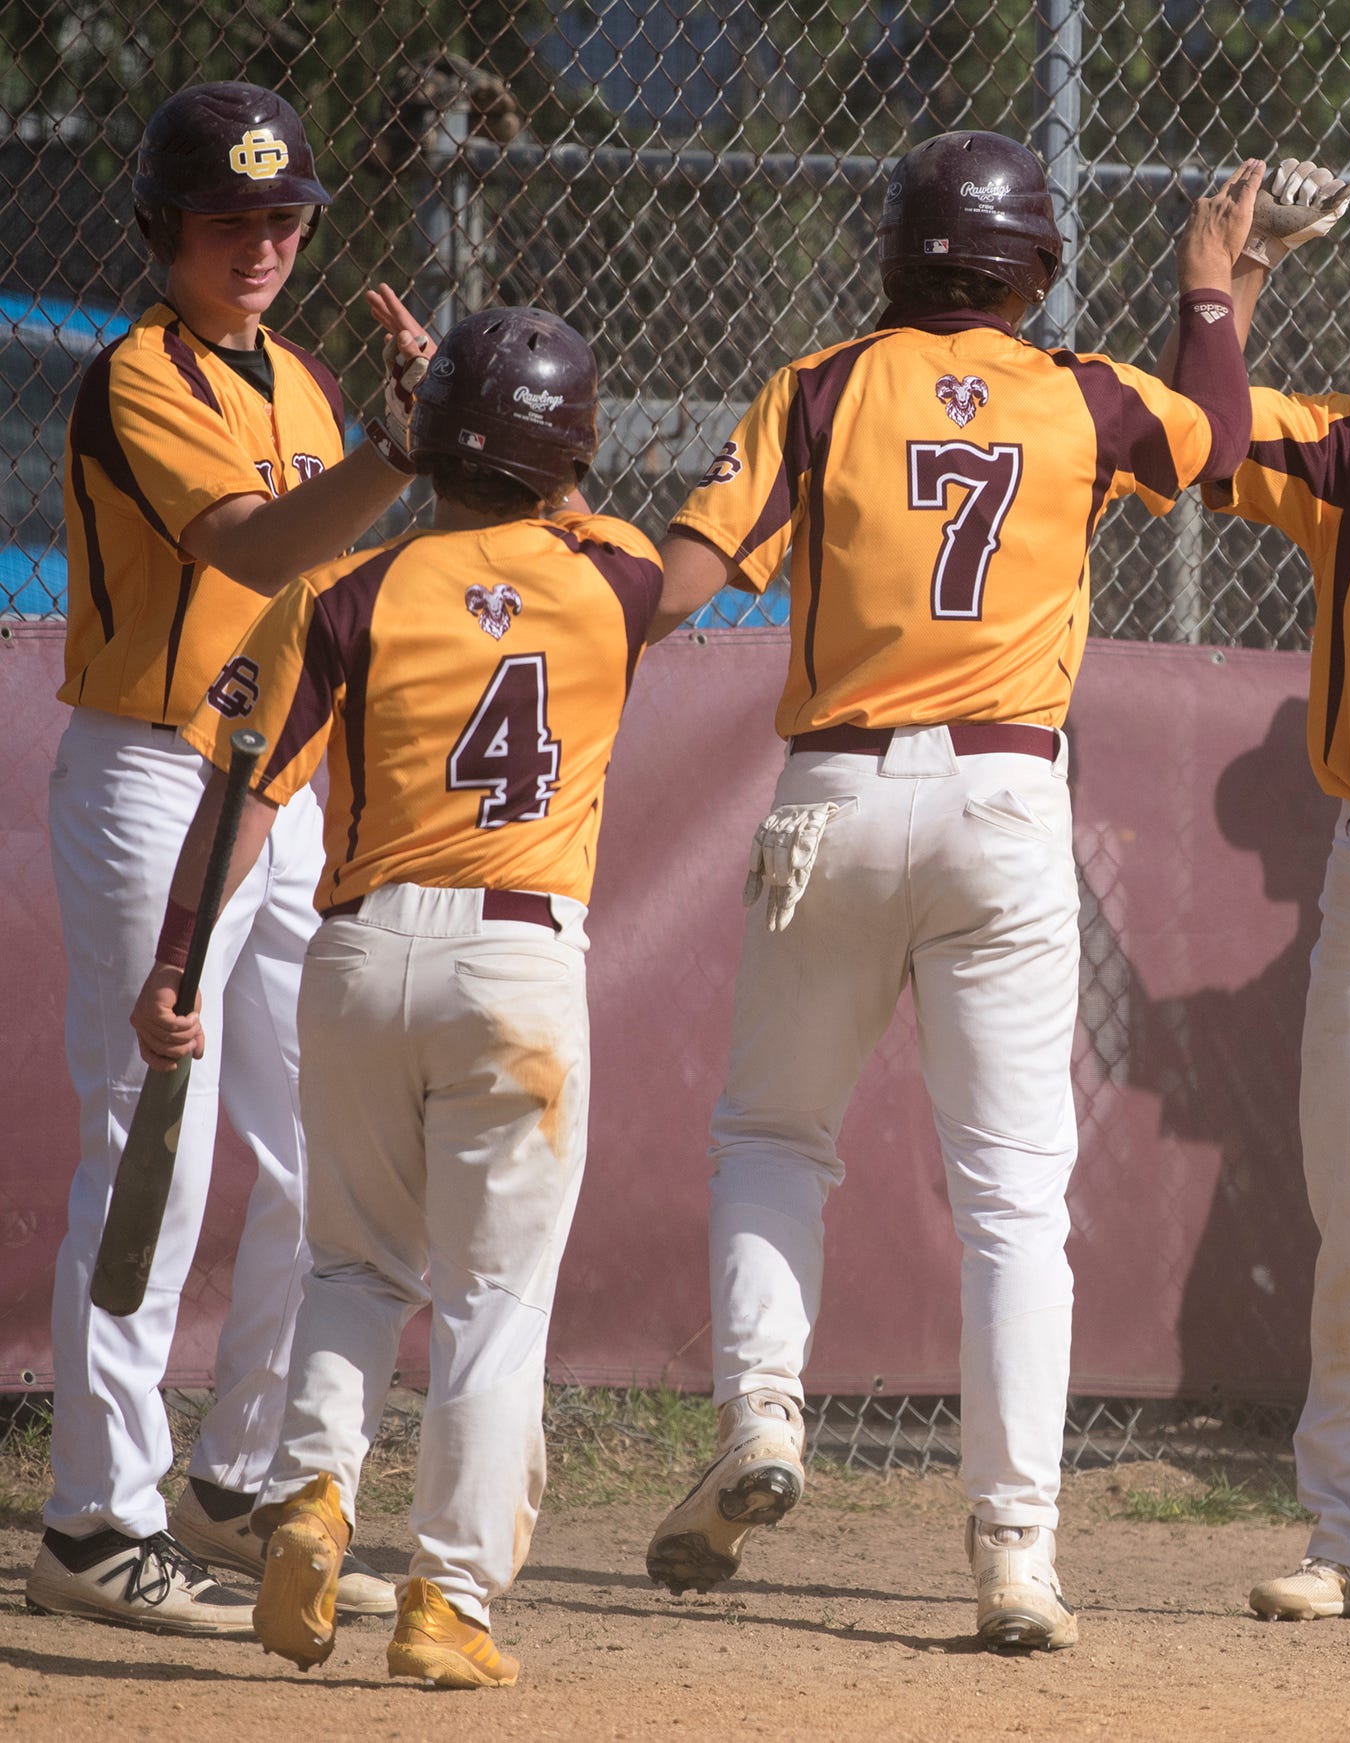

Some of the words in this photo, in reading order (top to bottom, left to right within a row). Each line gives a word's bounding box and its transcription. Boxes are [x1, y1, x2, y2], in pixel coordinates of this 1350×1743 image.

[960, 181, 1011, 201] Rawlings
[513, 386, 565, 412] Rawlings
[906, 440, 1023, 621] 7
[445, 651, 562, 829] 4
